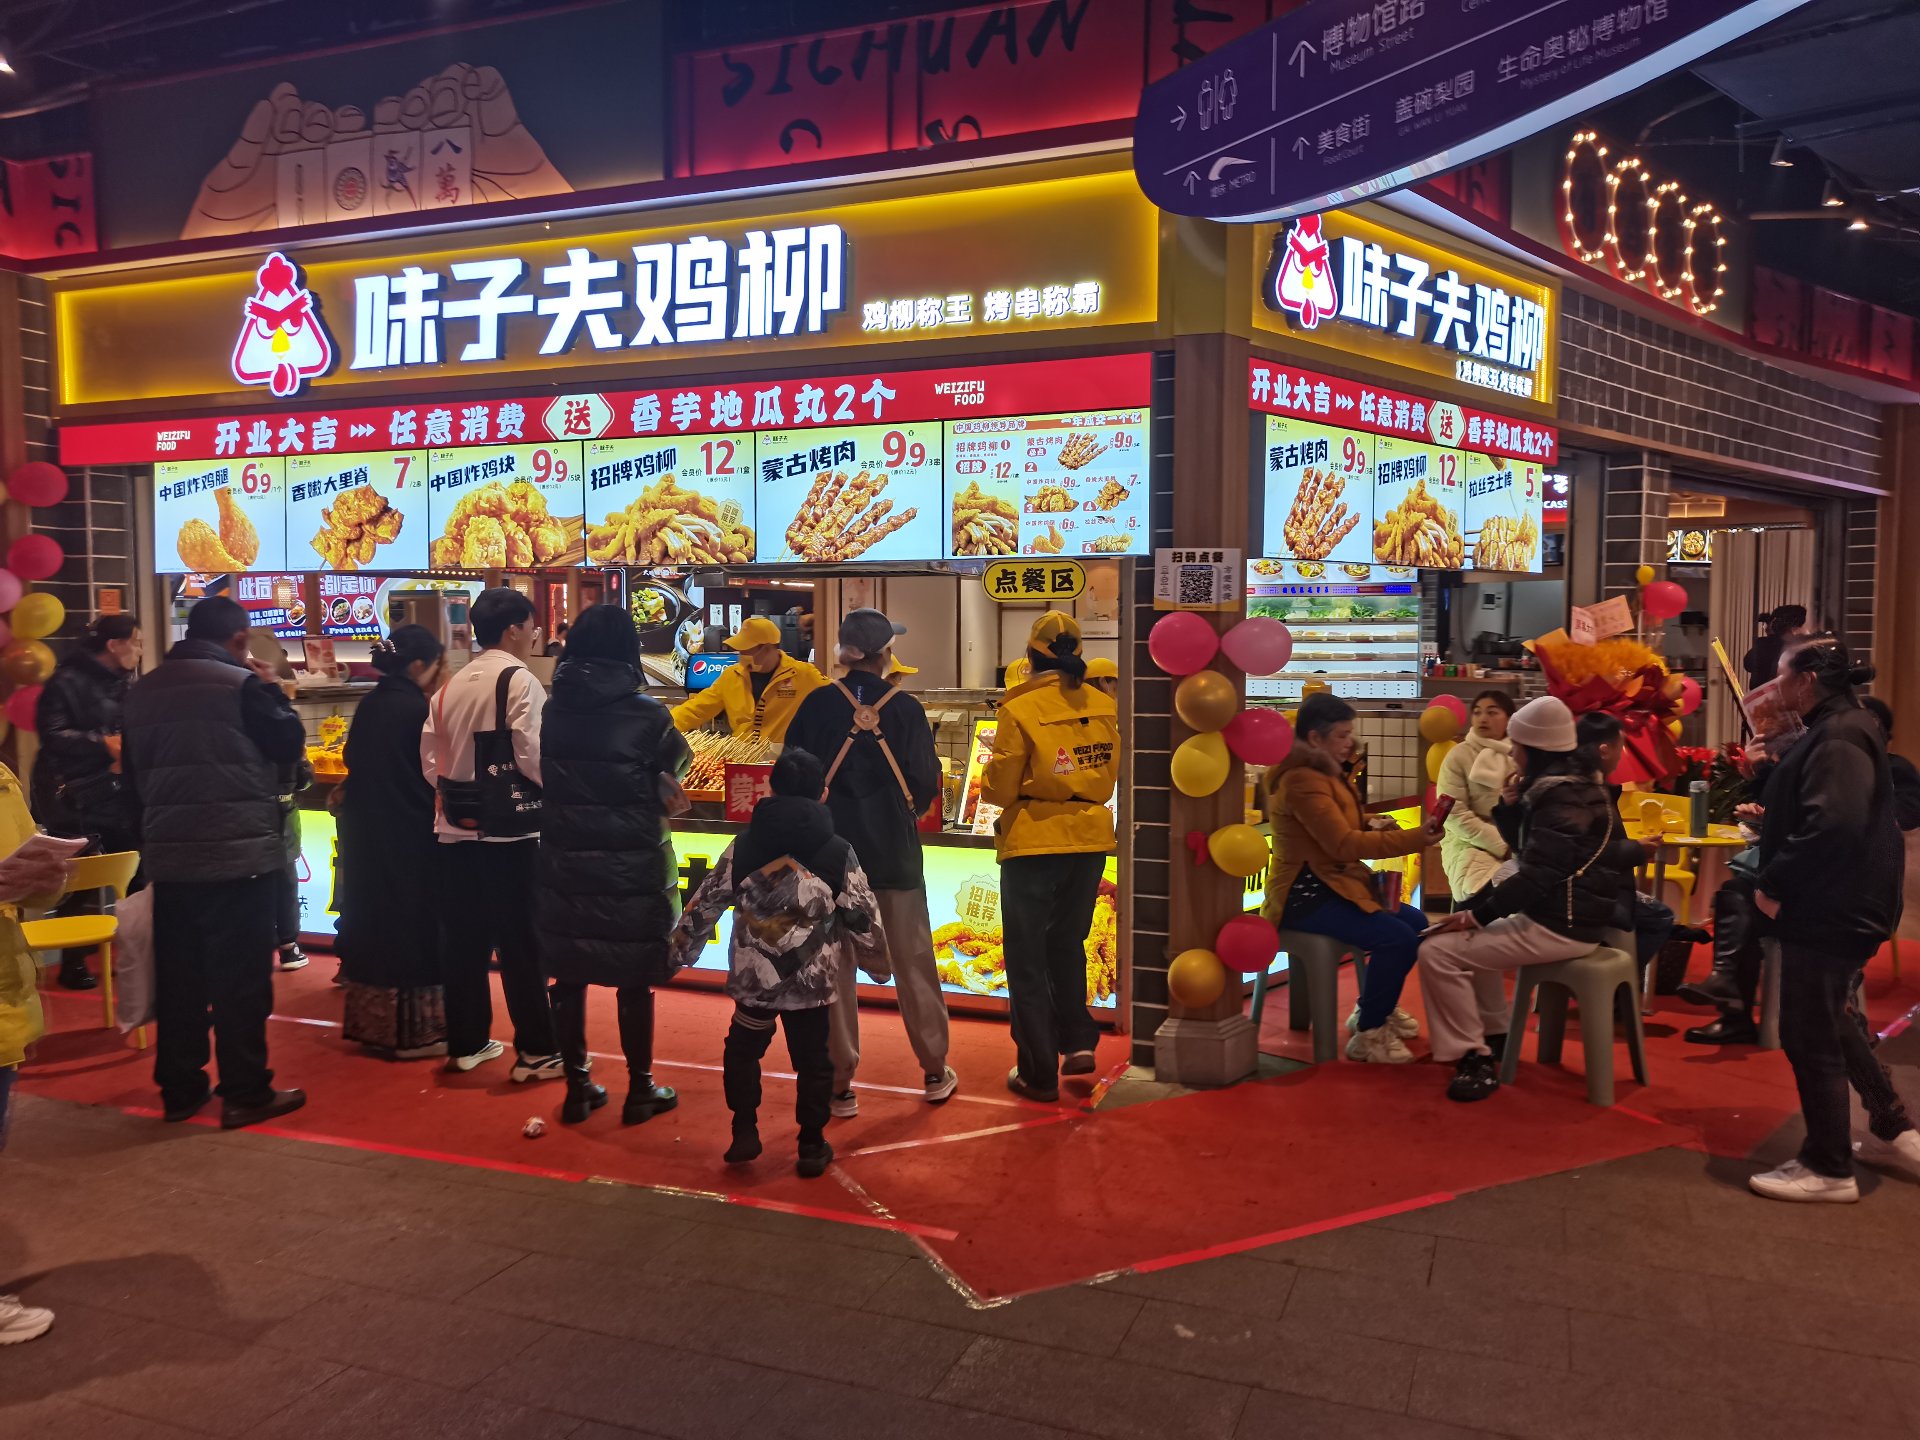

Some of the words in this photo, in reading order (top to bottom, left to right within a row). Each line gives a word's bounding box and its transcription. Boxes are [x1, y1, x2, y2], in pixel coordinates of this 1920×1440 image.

[1322, 0, 1425, 61] 博物馆路
[1497, 0, 1668, 83] 生命奥秘博物馆
[1395, 70, 1475, 123] 盖碗梨园
[1317, 114, 1371, 154] 美食街
[350, 224, 846, 371] 味子夫鸡柳
[862, 294, 972, 331] 鸡柳称王
[983, 281, 1100, 322] 烤串称霸
[1339, 235, 1544, 371] 味子夫鸡柳
[935, 380, 986, 395] WEIZIFU
[954, 393, 986, 406] FOOD
[215, 418, 337, 455] 开业大吉
[389, 403, 526, 446] 任意消费
[562, 396, 595, 436] 送
[630, 379, 898, 431] 香芋地瓜丸2个
[1252, 368, 1331, 414] 开业大吉
[1359, 390, 1425, 433] 任意消费
[1439, 408, 1453, 439] 送
[1468, 416, 1553, 458] 香芋地瓜丸2个
[157, 430, 191, 441] WEIZIFU
[157, 440, 177, 451] FOOD
[860, 461, 883, 469] 会员价
[882, 431, 926, 468] 9.9
[956, 440, 998, 453] 招牌鸡柳
[1114, 431, 1133, 448] 9.9
[532, 449, 568, 483] 9.9
[591, 447, 677, 491] 招牌鸡柳
[681, 468, 702, 477] 会员价
[700, 439, 735, 475] 12
[762, 440, 856, 483] 蒙古烤肉
[959, 461, 983, 474] 招牌
[995, 461, 1011, 479] 12
[1027, 463, 1034, 472] 2
[1269, 439, 1328, 472] 蒙古烤肉
[1342, 436, 1366, 475] 9.9
[1377, 454, 1427, 486] 招牌鸡柳
[1439, 453, 1456, 487] 12
[159, 468, 229, 501] 中国炸鸡腿
[241, 463, 271, 494] 6.9
[292, 467, 370, 502] 香嫩大里脊
[394, 457, 411, 489] 7
[430, 455, 515, 492] 中国炸鸡块
[1130, 474, 1137, 486] 7
[1469, 473, 1513, 498] 拉丝芝士棒
[1525, 467, 1534, 497] 5
[1026, 503, 1033, 513] 3
[1086, 501, 1093, 511] 4
[1128, 516, 1136, 528] 5
[1025, 545, 1032, 554] 5
[1085, 543, 1092, 553] 6
[1171, 551, 1224, 563] 扫码点餐
[995, 567, 1075, 594] 点餐区
[329, 627, 355, 635] Fresh
[966, 901, 996, 921] 推荐
[969, 885, 999, 907] 招牌
